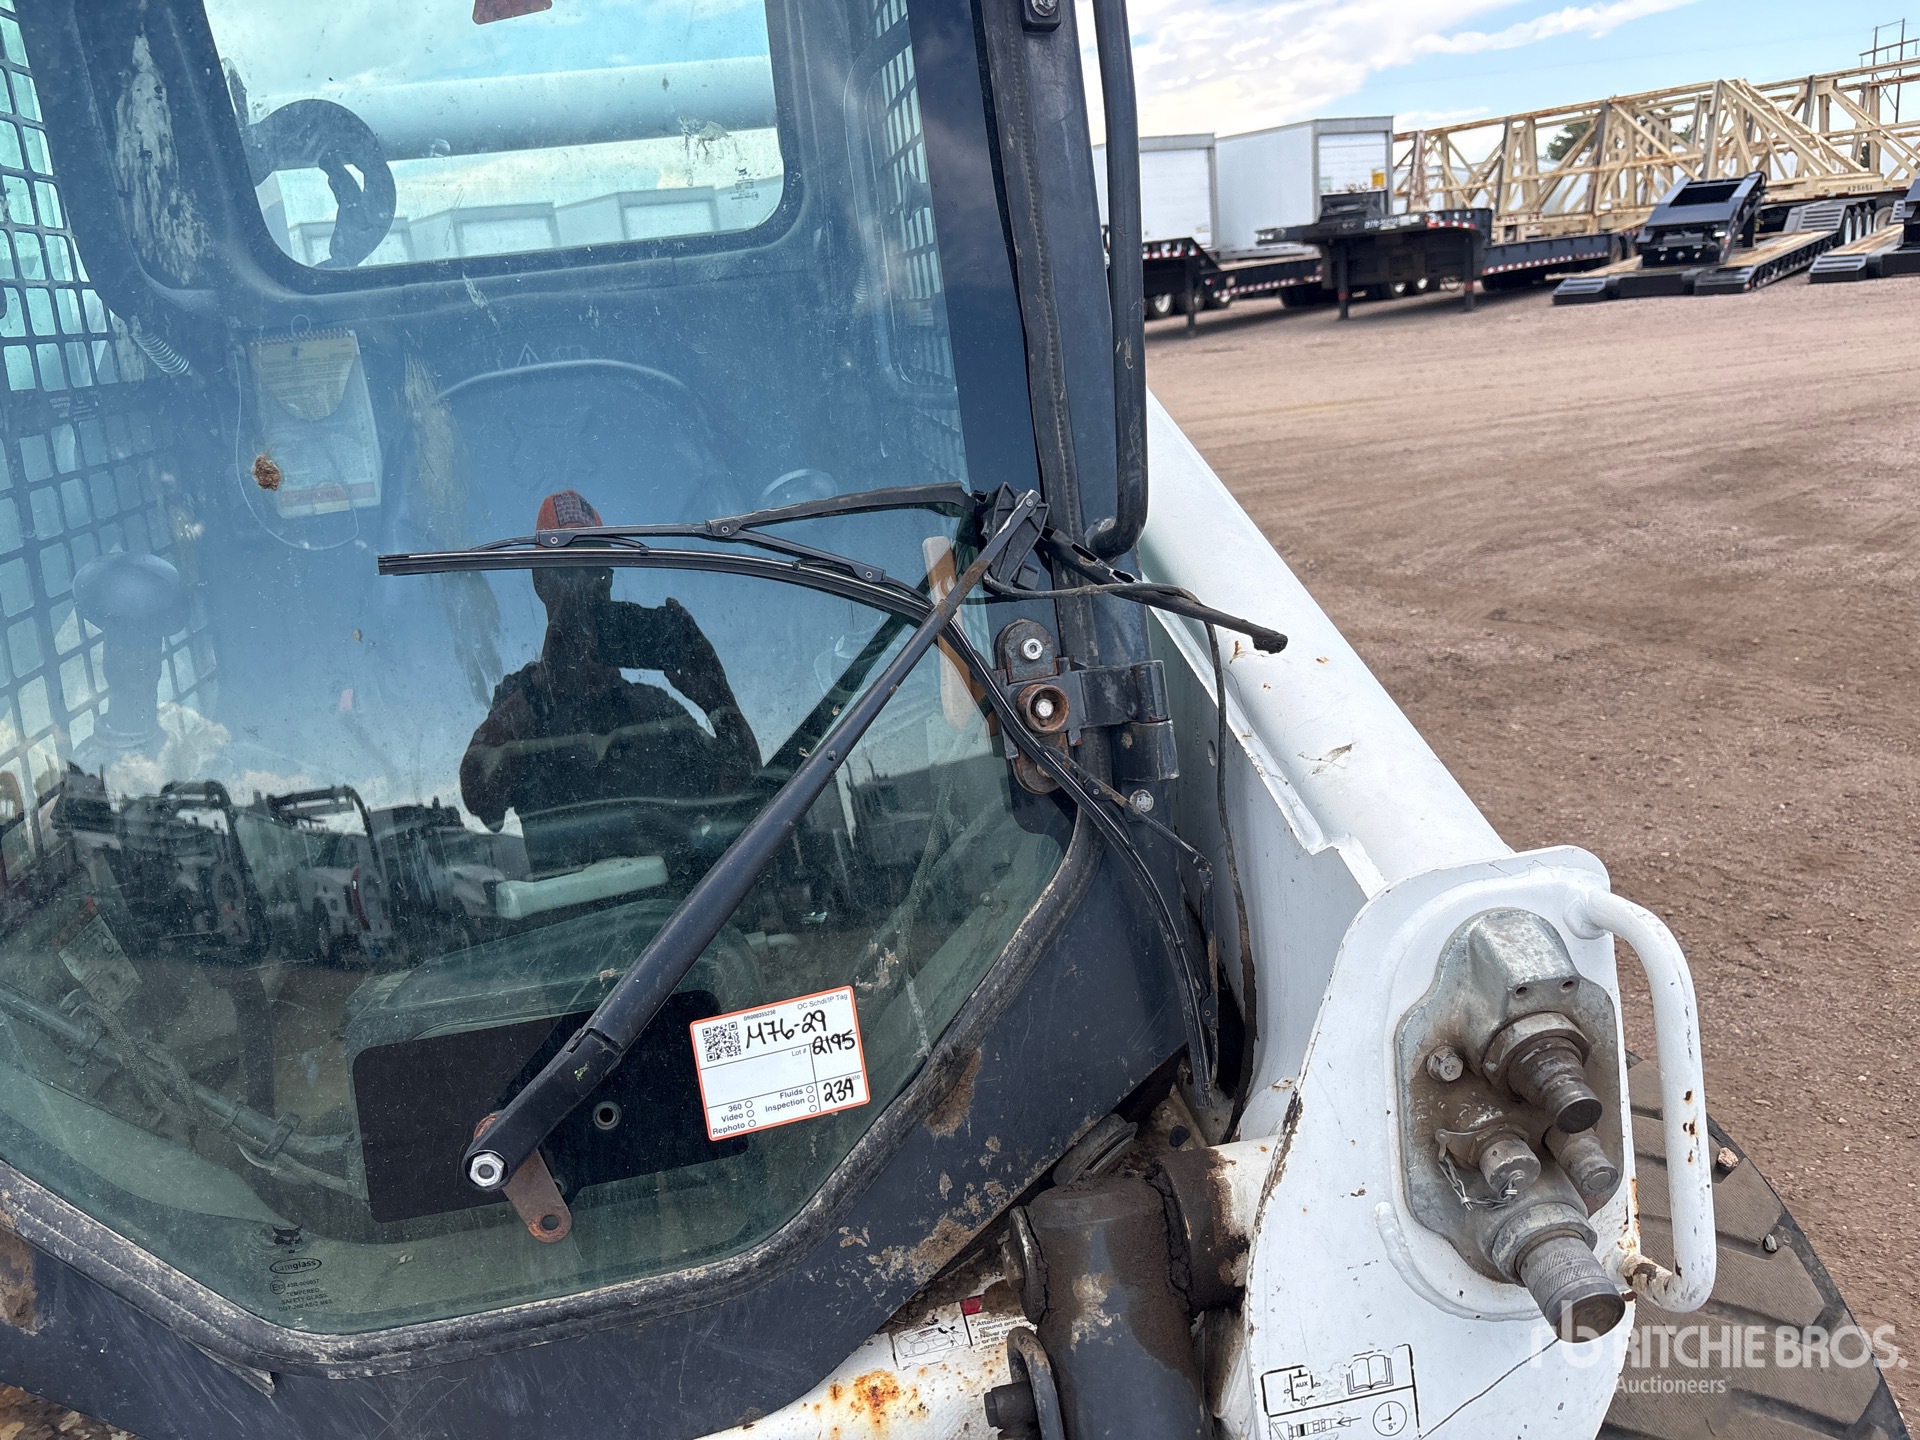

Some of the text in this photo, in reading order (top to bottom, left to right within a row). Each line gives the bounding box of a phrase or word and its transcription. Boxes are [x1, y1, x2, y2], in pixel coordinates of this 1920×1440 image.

[836, 993, 848, 1002] Tag
[779, 1088, 803, 1099] Fluids
[728, 1103, 742, 1112] 360
[765, 1098, 805, 1112] Inspection
[721, 1113, 743, 1122] Video
[712, 1122, 745, 1135] Rephoto
